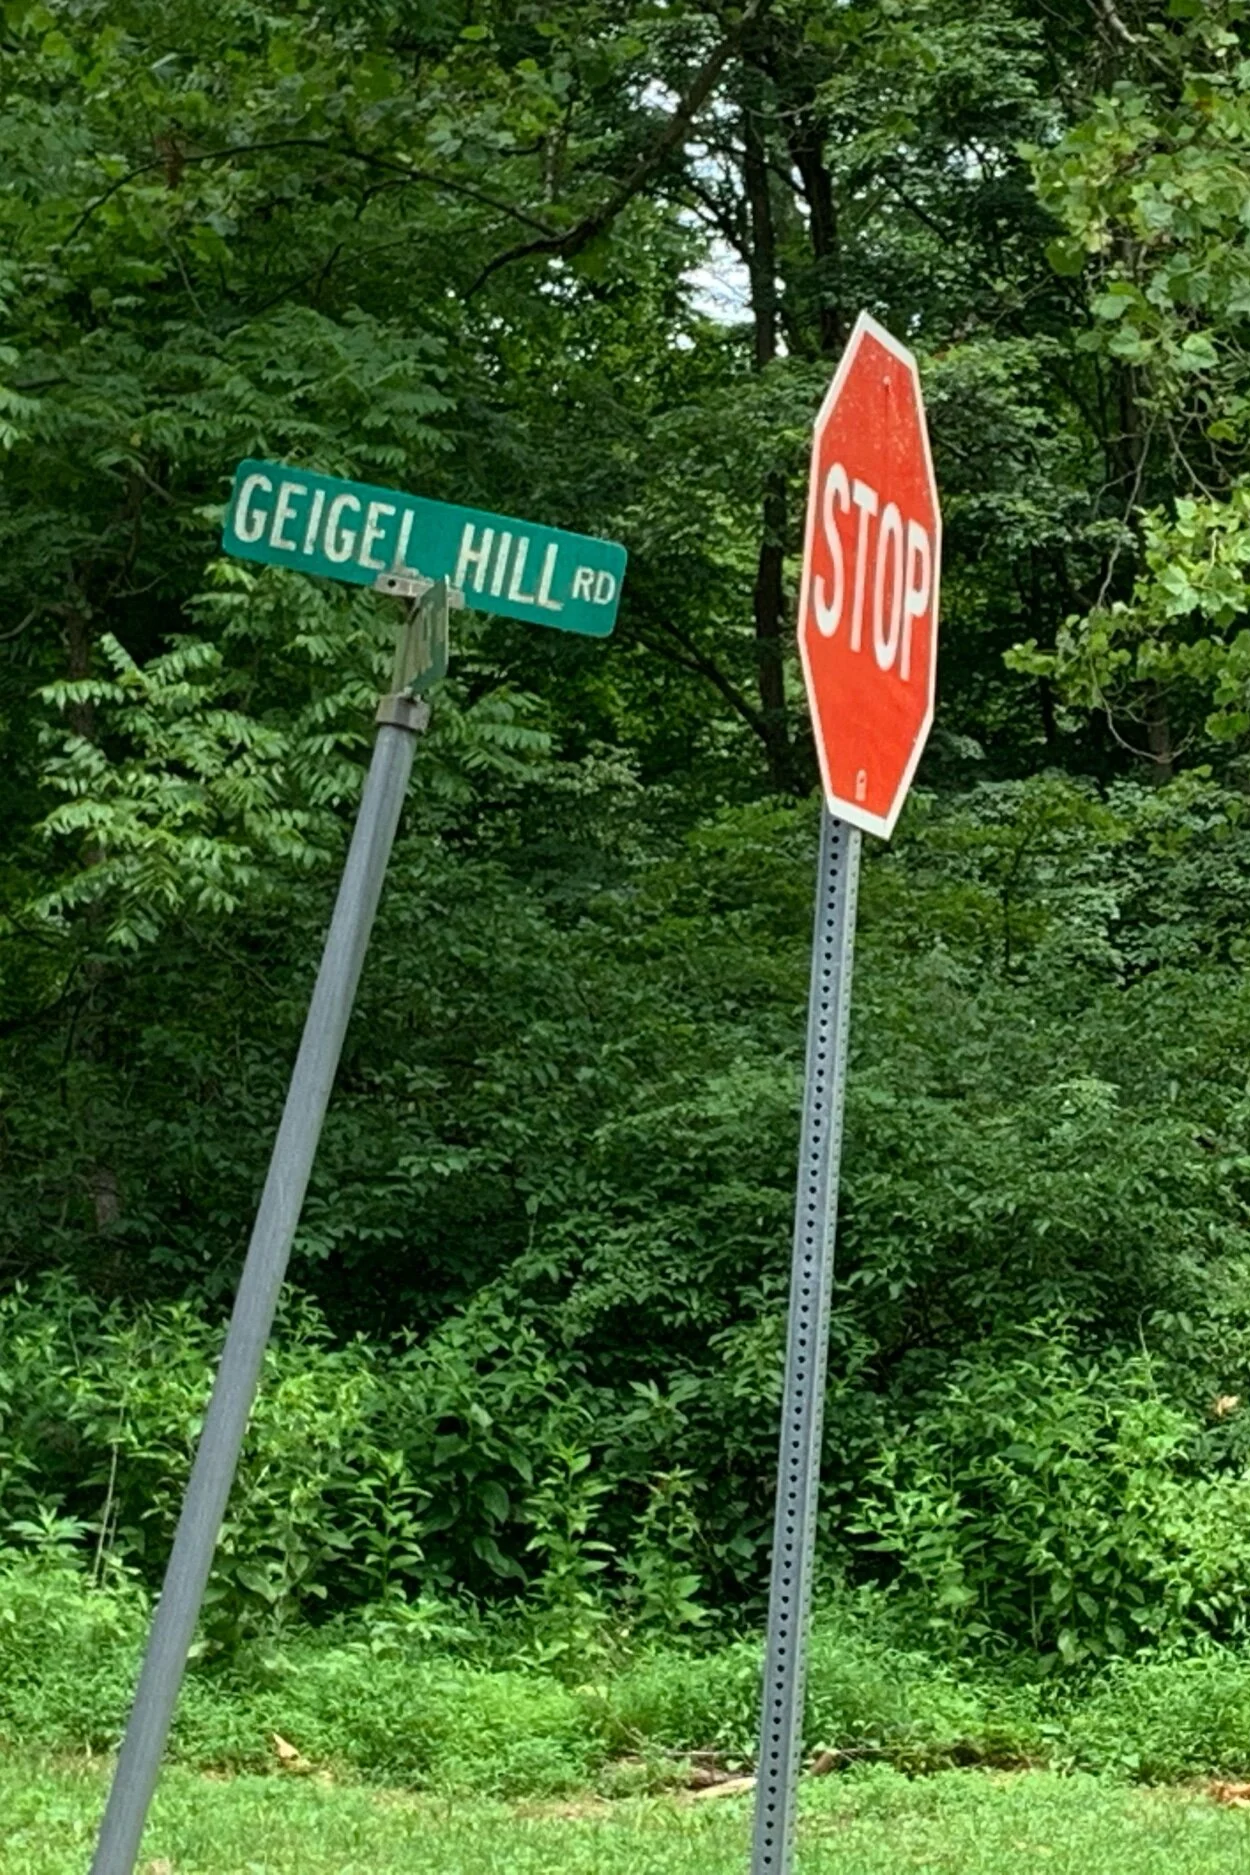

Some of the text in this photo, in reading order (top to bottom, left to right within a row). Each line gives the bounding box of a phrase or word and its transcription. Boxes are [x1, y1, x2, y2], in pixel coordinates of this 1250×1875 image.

[234, 473, 616, 610] GEIGEL HILL RD
[814, 462, 930, 681] STOP
